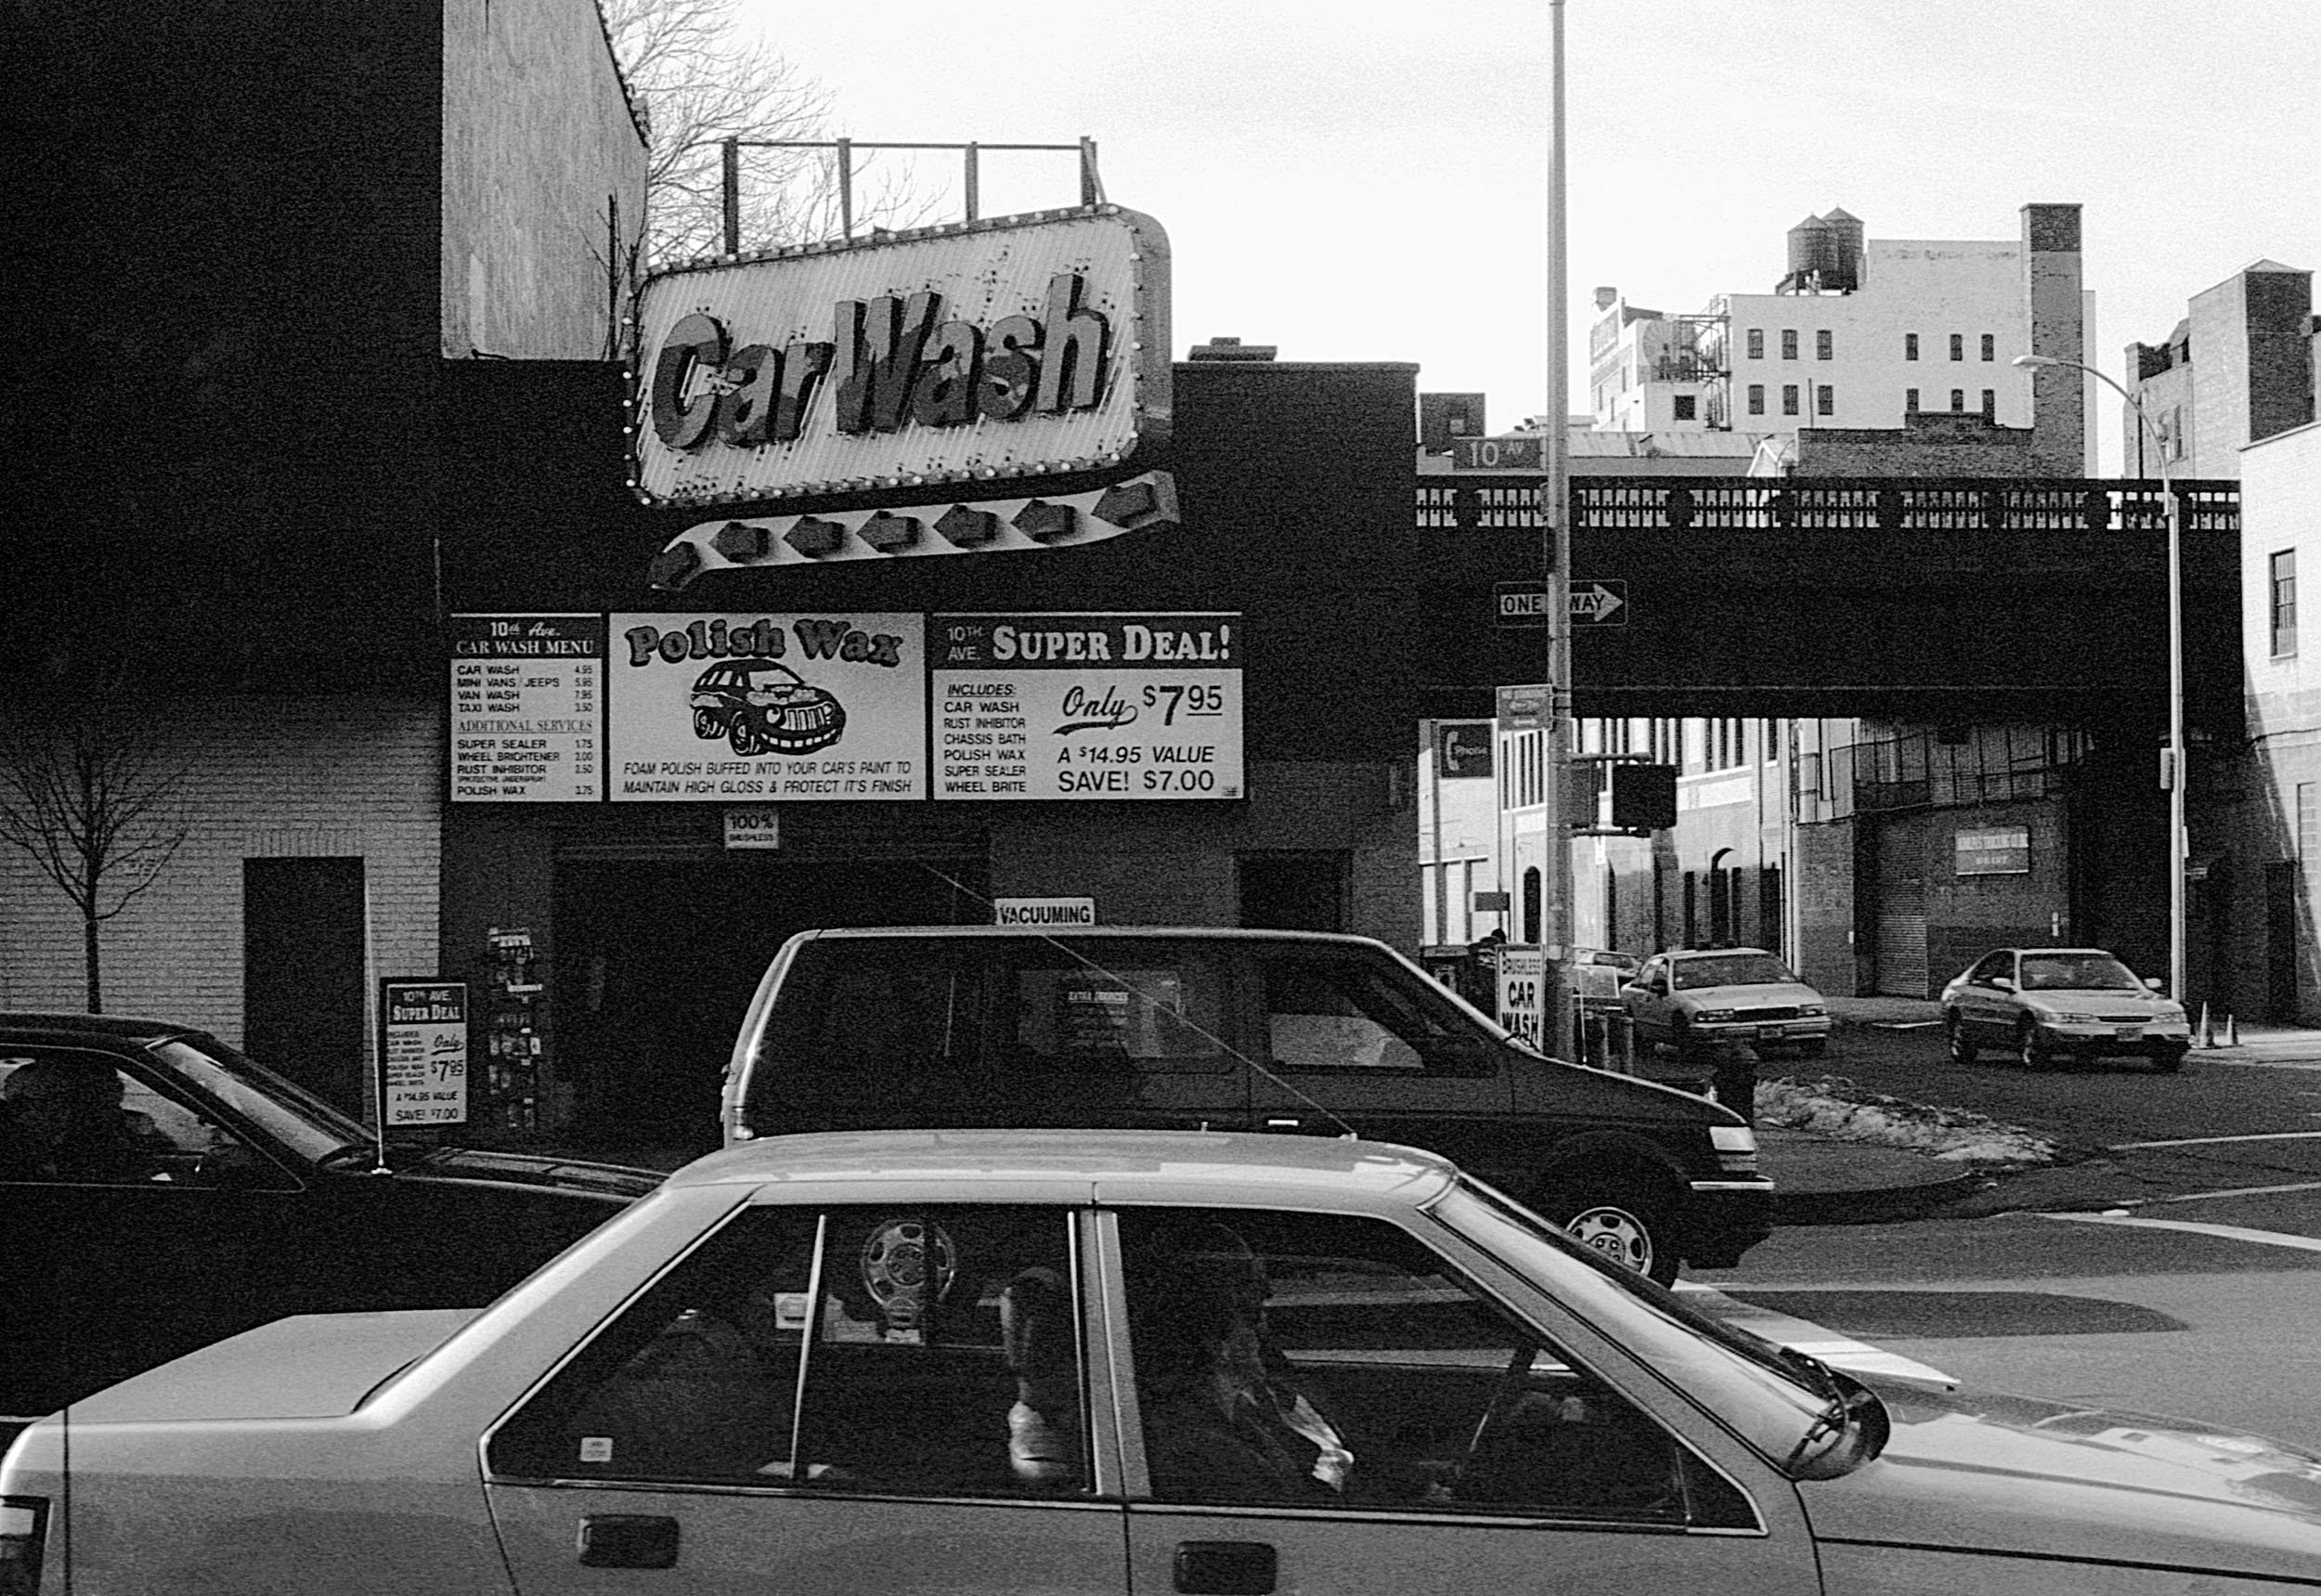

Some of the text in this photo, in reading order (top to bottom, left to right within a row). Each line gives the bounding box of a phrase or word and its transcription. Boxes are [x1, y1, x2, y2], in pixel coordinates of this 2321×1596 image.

[652, 274, 1110, 450] Car Wash
[1470, 441, 1499, 466] 10
[1504, 595, 1542, 613] ONE
[490, 621, 561, 637] 10th Ave.
[947, 626, 982, 642] 10TH
[456, 640, 594, 654] CAR WASH MENU
[625, 618, 903, 668] Polish Wax
[992, 624, 1230, 660] SUPER DEAL!
[947, 646, 981, 661] AVE.
[457, 665, 592, 675] CAR WASH 4.95
[457, 690, 481, 700] VAN
[486, 690, 520, 700] WASH
[947, 684, 1017, 696] INCLUDES:
[458, 703, 482, 712] TAXI
[487, 703, 520, 712] WASH
[944, 702, 1019, 713] CAR WASH
[1061, 685, 1137, 730] Only
[458, 720, 592, 732] ADDITIONAL SERVICES
[944, 718, 1026, 729] RUST INHIBITOR
[457, 739, 496, 749] SUPER
[501, 739, 547, 749] SEALER
[943, 733, 1026, 745] CHASSIS BATH
[457, 751, 593, 761] WHEEL BRIGHTENER 2.00
[944, 749, 1026, 760] POLISH WAX
[1057, 746, 1215, 763] A $14.95 VALUE
[457, 764, 487, 774] RUST
[492, 764, 547, 774] INHIBITOR
[624, 761, 912, 774] FOAM POLISH BUFFED INTO YOUR CAR'S PAINT TO
[944, 765, 1026, 776] SUPER SEALER
[623, 780, 912, 793] MAINTAIN HIGH GLOSS & PROTECT IT'S FINISH
[944, 781, 1026, 792] WHEEL BRITE
[1057, 771, 1129, 792] SAVE!
[1143, 770, 1214, 791] $7.00
[457, 785, 497, 796] POLISH
[502, 785, 525, 796] WAX
[730, 813, 773, 829] 100%
[1000, 905, 1091, 924] VACUUMING
[1508, 981, 1535, 1008] CAR
[393, 1004, 461, 1020] SUPER DEAL
[1502, 1012, 1539, 1042] WASH
